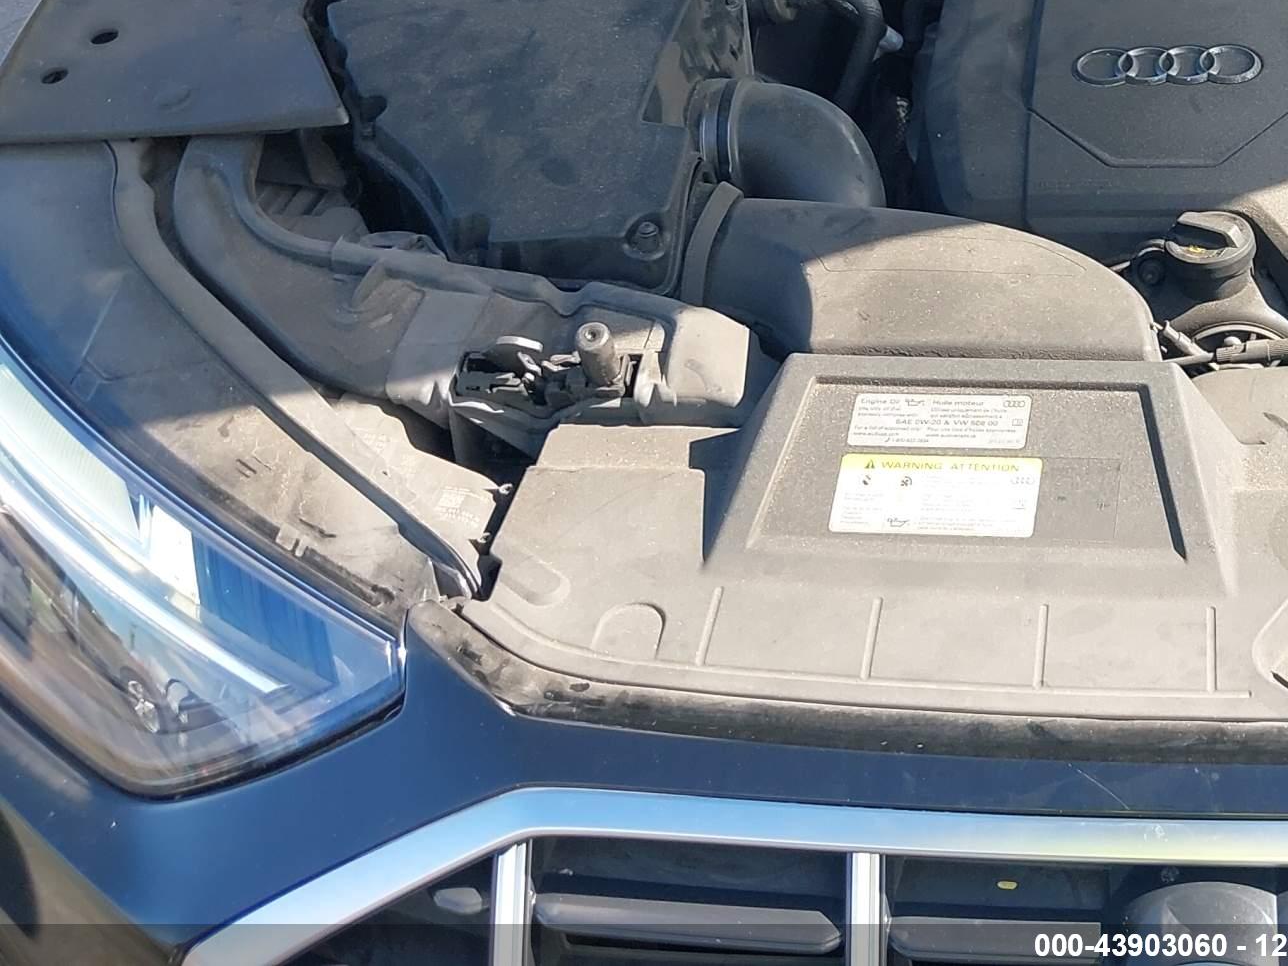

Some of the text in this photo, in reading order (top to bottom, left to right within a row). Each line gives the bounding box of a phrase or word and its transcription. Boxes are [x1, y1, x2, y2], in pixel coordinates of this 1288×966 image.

[860, 397, 887, 406] Engine
[880, 461, 1020, 472] WARNING ATTENTION
